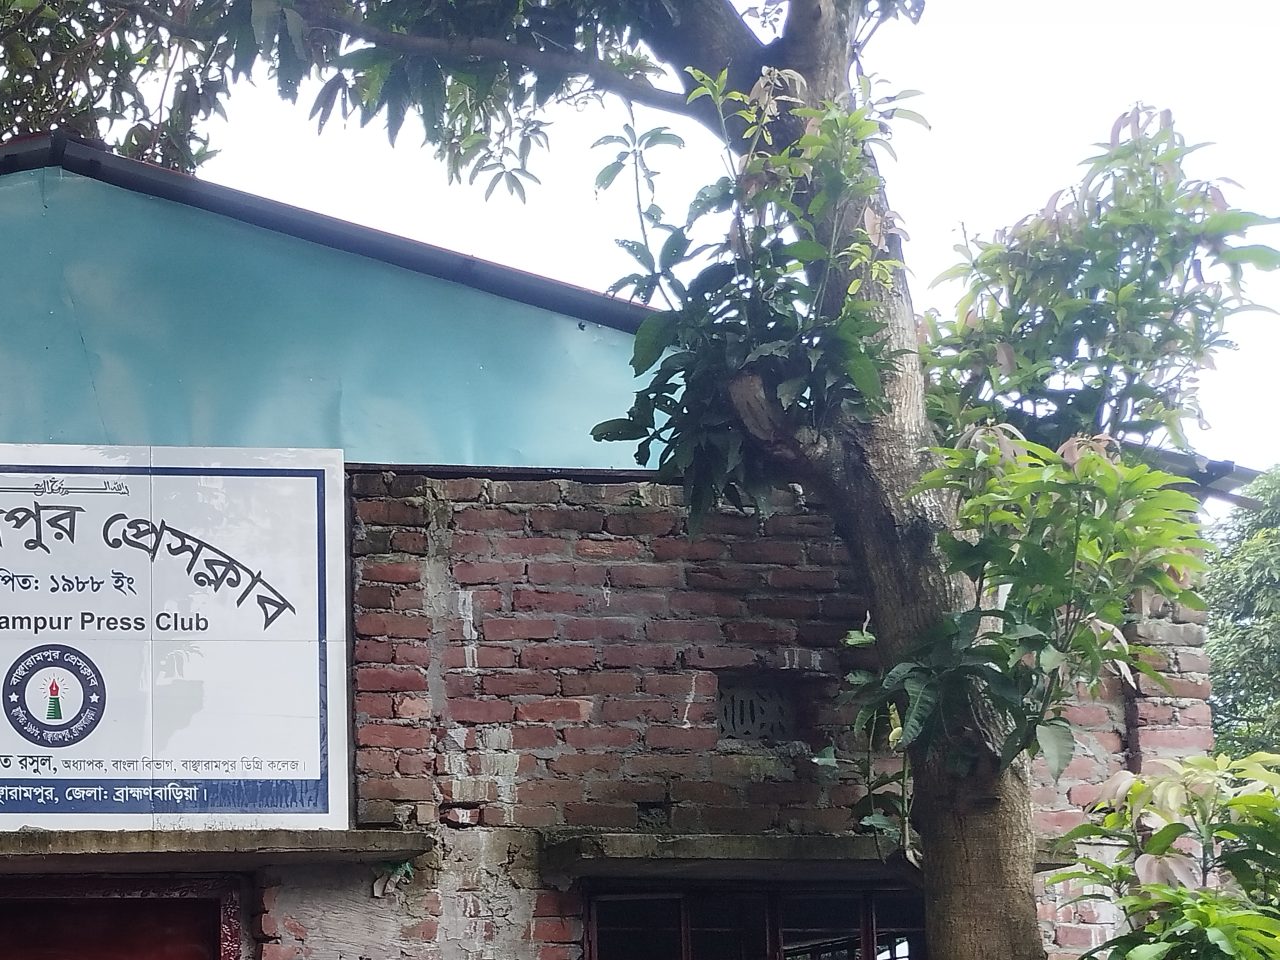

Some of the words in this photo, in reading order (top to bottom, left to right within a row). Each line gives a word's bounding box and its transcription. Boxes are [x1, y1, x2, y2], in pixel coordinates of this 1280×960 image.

[50, 574, 105, 593] ১৯৮৮
[111, 569, 137, 596] ইং
[102, 513, 296, 631] প্রেসক্লাব
[81, 611, 146, 632] Press
[155, 612, 210, 632] Club
[10, 650, 61, 686] বাঞ্ছারামপুর
[63, 652, 99, 687] প্রেসক্লাব
[17, 754, 58, 775] রসুল,
[61, 759, 108, 774] অধ্যাপক,
[111, 759, 139, 772] বাংলা
[141, 756, 178, 773] বিভাগ,
[180, 759, 237, 774] বাঞ্ছারামপুর
[240, 756, 263, 771] ডিগ্রি
